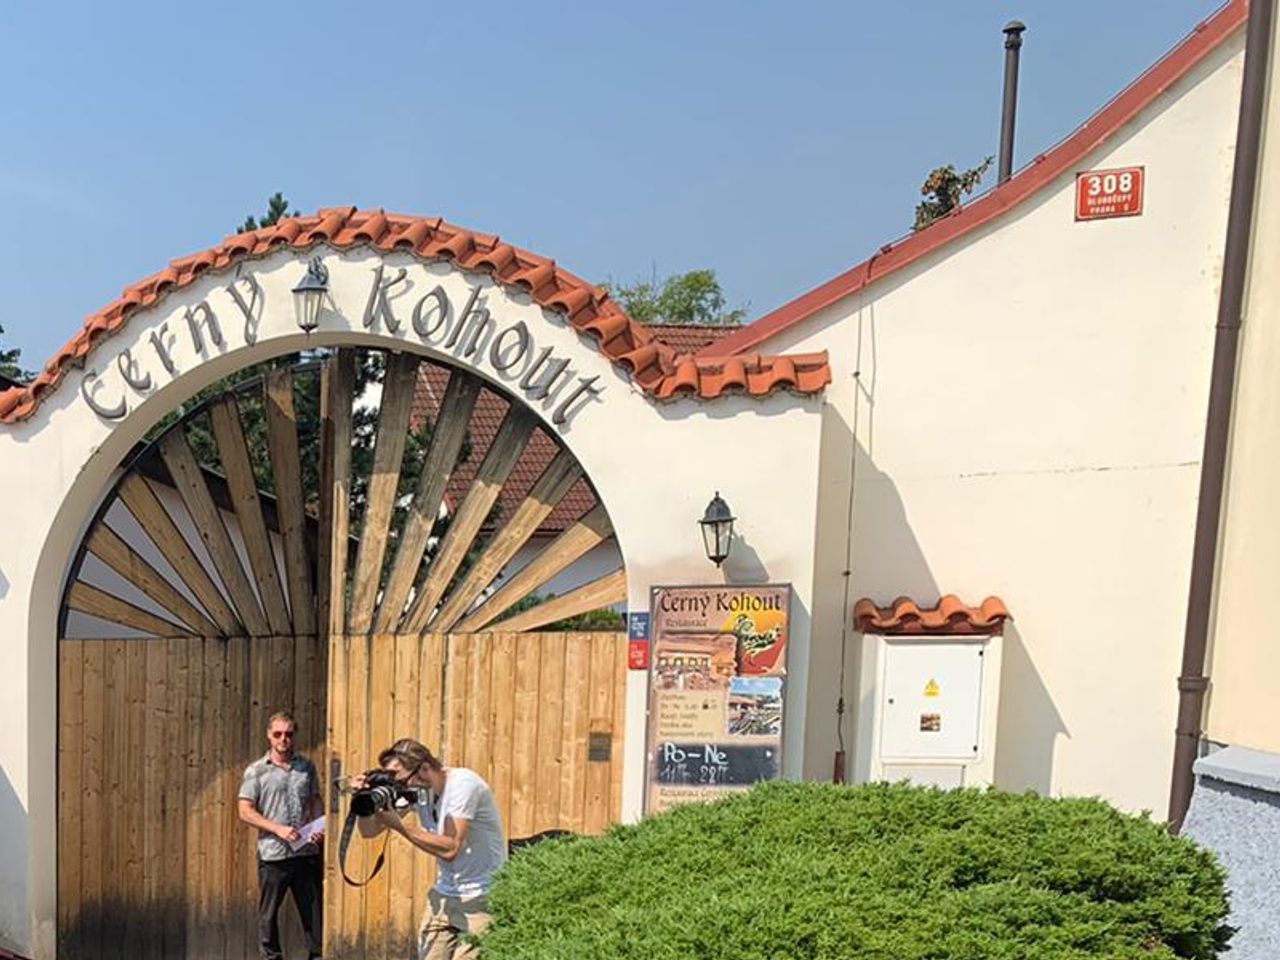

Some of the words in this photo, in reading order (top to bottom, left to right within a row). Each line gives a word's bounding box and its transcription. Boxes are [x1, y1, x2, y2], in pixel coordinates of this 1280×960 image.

[1088, 172, 1132, 196] 308
[363, 264, 601, 425] Kohout
[716, 591, 781, 612] Kohout
